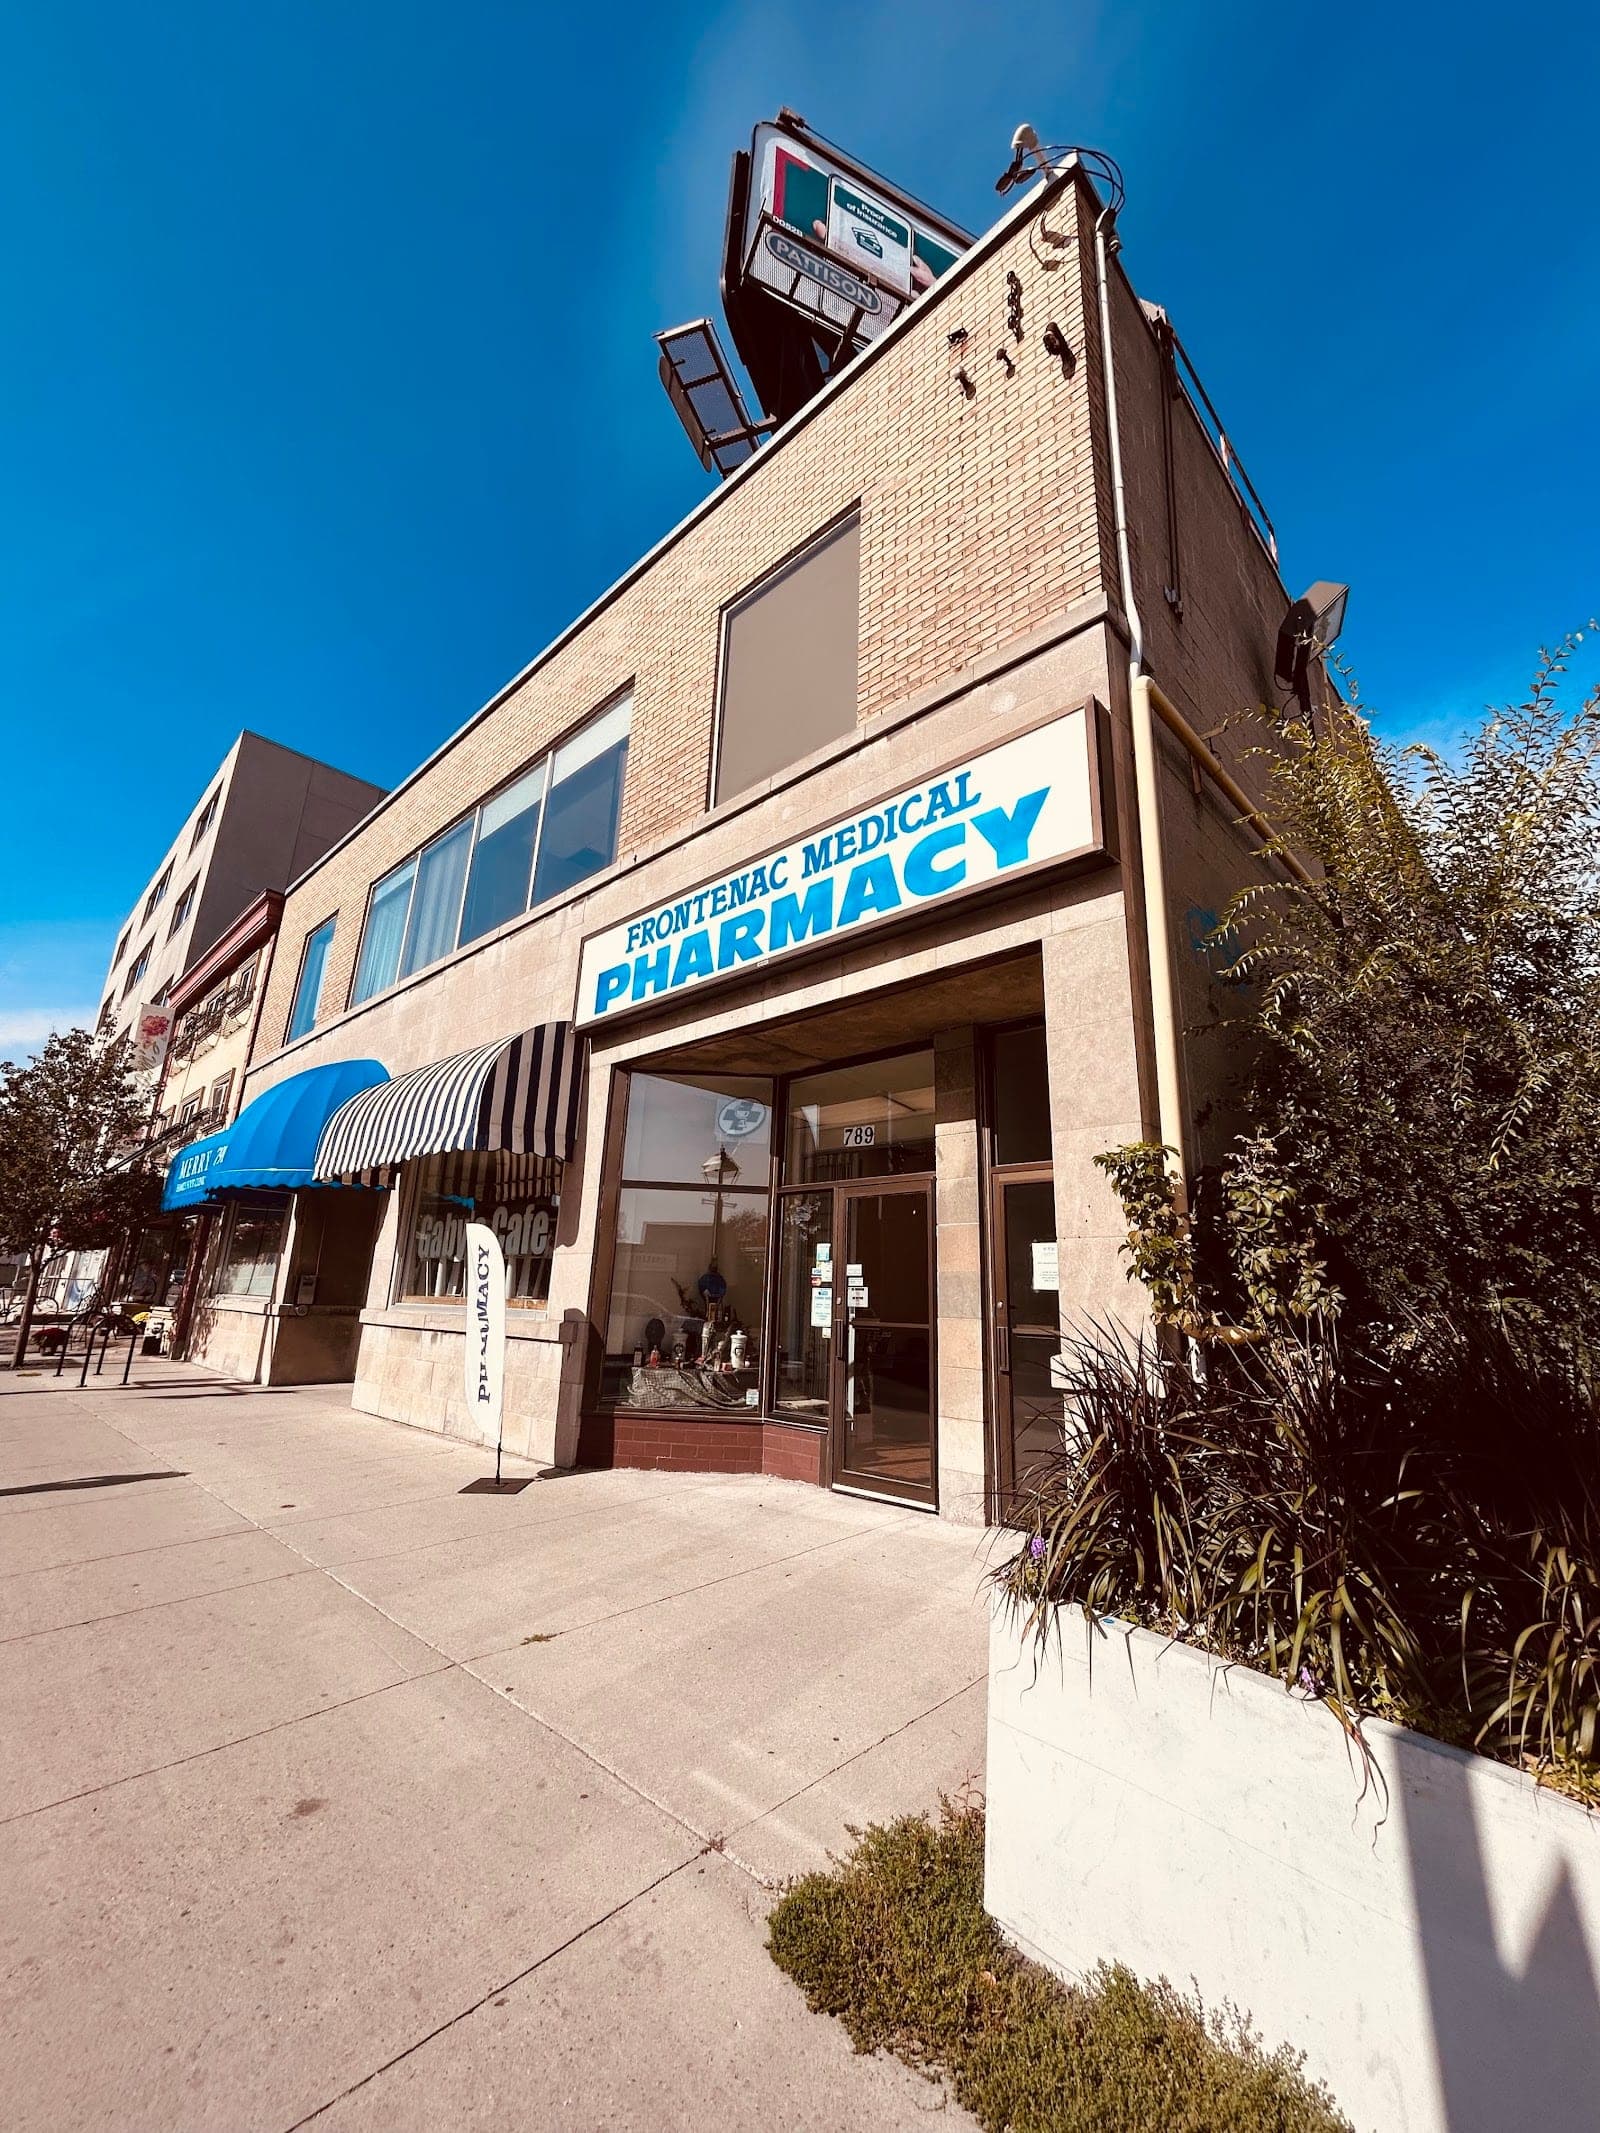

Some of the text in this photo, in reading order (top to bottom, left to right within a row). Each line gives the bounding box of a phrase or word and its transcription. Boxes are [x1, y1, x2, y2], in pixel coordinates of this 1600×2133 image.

[861, 202, 885, 222] Proof
[776, 239, 873, 307] PATTISON
[626, 770, 983, 954] FRONTENAC MEDICAL
[594, 786, 1052, 1015] PHARMACY
[845, 1126, 874, 1145] 789
[178, 1150, 213, 1179] MERRY
[417, 1204, 549, 1259] Gaby' Cafe
